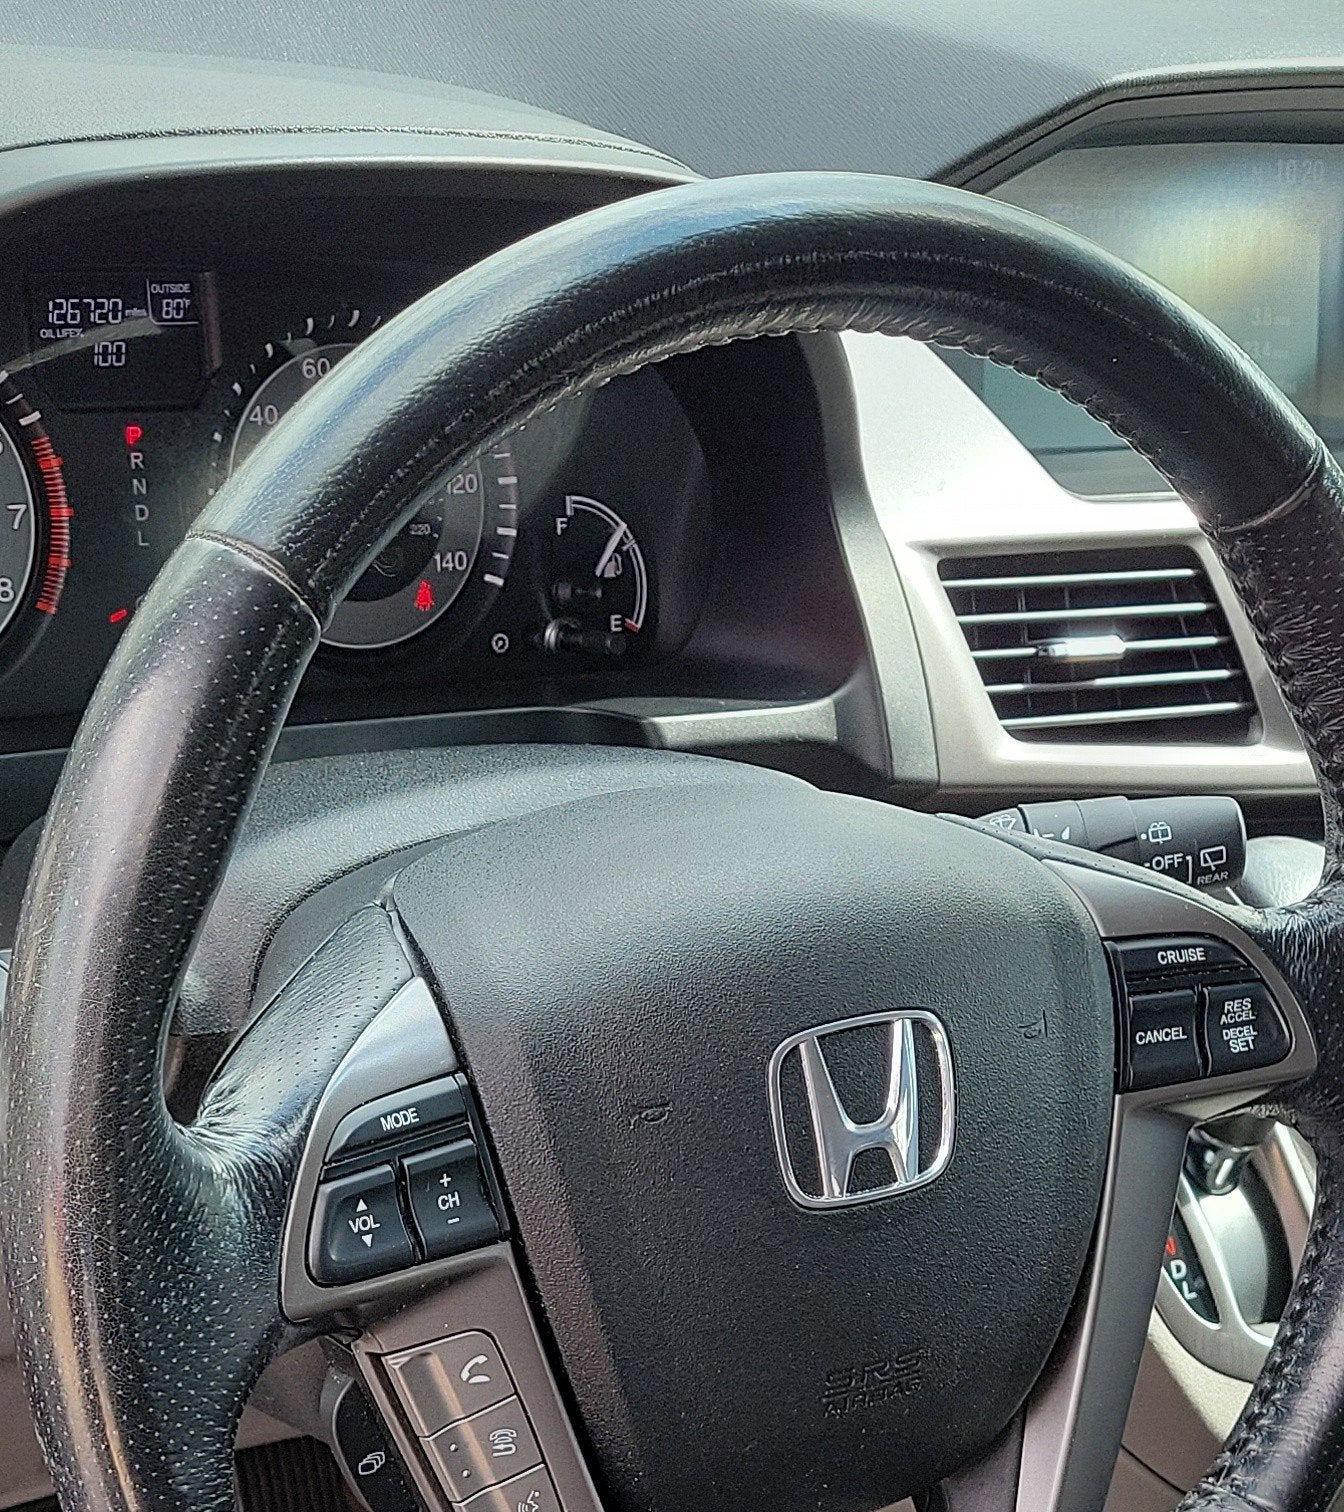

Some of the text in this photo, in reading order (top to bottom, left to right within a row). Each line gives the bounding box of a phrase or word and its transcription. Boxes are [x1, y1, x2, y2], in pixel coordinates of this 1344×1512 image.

[150, 283, 191, 294] OUTSIDE
[48, 298, 123, 324] 126720
[39, 328, 55, 339] OIL
[94, 342, 126, 366] 100
[302, 358, 331, 379] 60
[249, 405, 278, 426] 40
[126, 426, 142, 445] P
[130, 452, 144, 470] R
[132, 478, 147, 495] N
[6, 503, 27, 530] 7
[135, 504, 149, 520] D
[556, 518, 568, 536] F
[138, 530, 150, 546] L
[434, 550, 468, 572] 140
[610, 614, 622, 631] E
[1151, 852, 1184, 871] OFF
[1196, 870, 1229, 885] REAR
[1157, 947, 1206, 965] CRUISE
[1224, 998, 1252, 1013] RES
[1220, 1010, 1256, 1024] ACCEL
[1135, 1025, 1187, 1045] CANCEL
[1223, 1026, 1257, 1039] DECEL
[1229, 1037, 1255, 1053] SET
[380, 1107, 420, 1131] MODE
[437, 1192, 460, 1211] CH
[348, 1215, 381, 1234] VOL
[1170, 1259, 1187, 1280] D
[1182, 1280, 1198, 1300] L
